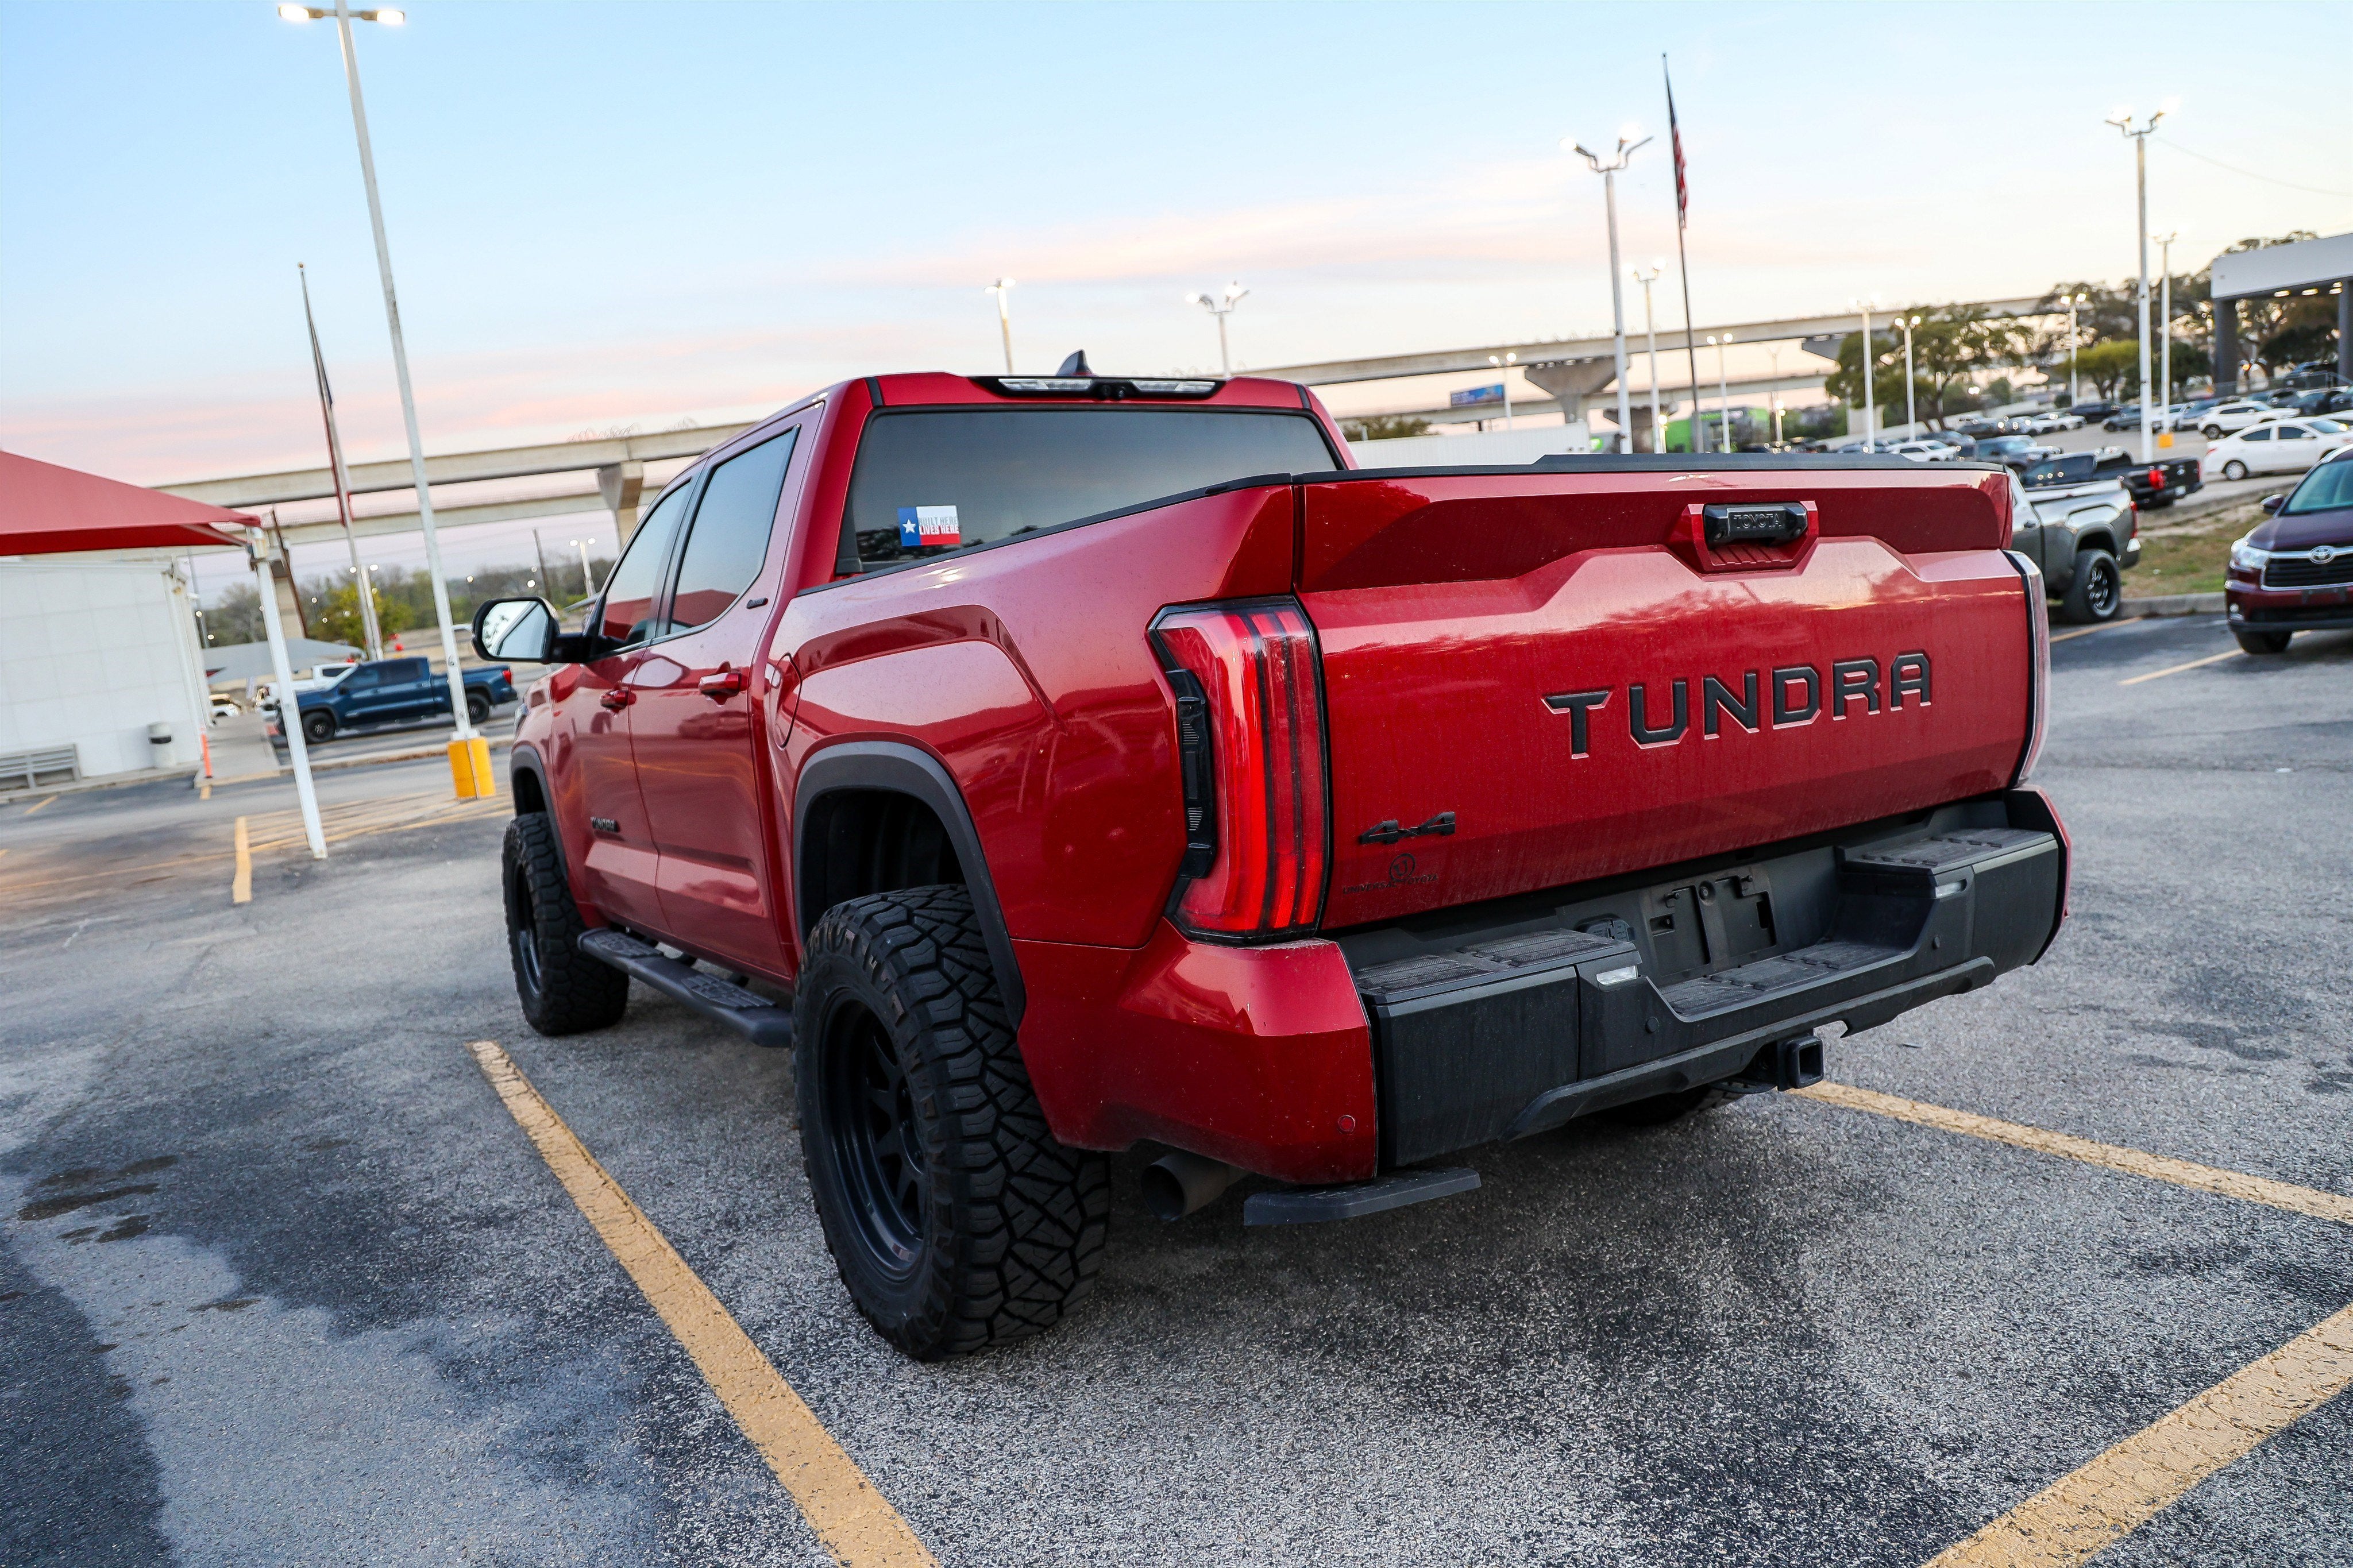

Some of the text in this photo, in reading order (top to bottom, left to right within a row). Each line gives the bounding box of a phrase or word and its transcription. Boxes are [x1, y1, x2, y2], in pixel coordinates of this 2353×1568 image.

[919, 524, 959, 535] LIVES HERE
[1733, 513, 1782, 528] TOYOTA
[1541, 652, 1932, 759] TUNDRA
[1343, 873, 1437, 894] UNIVERSAL TOYOTA
